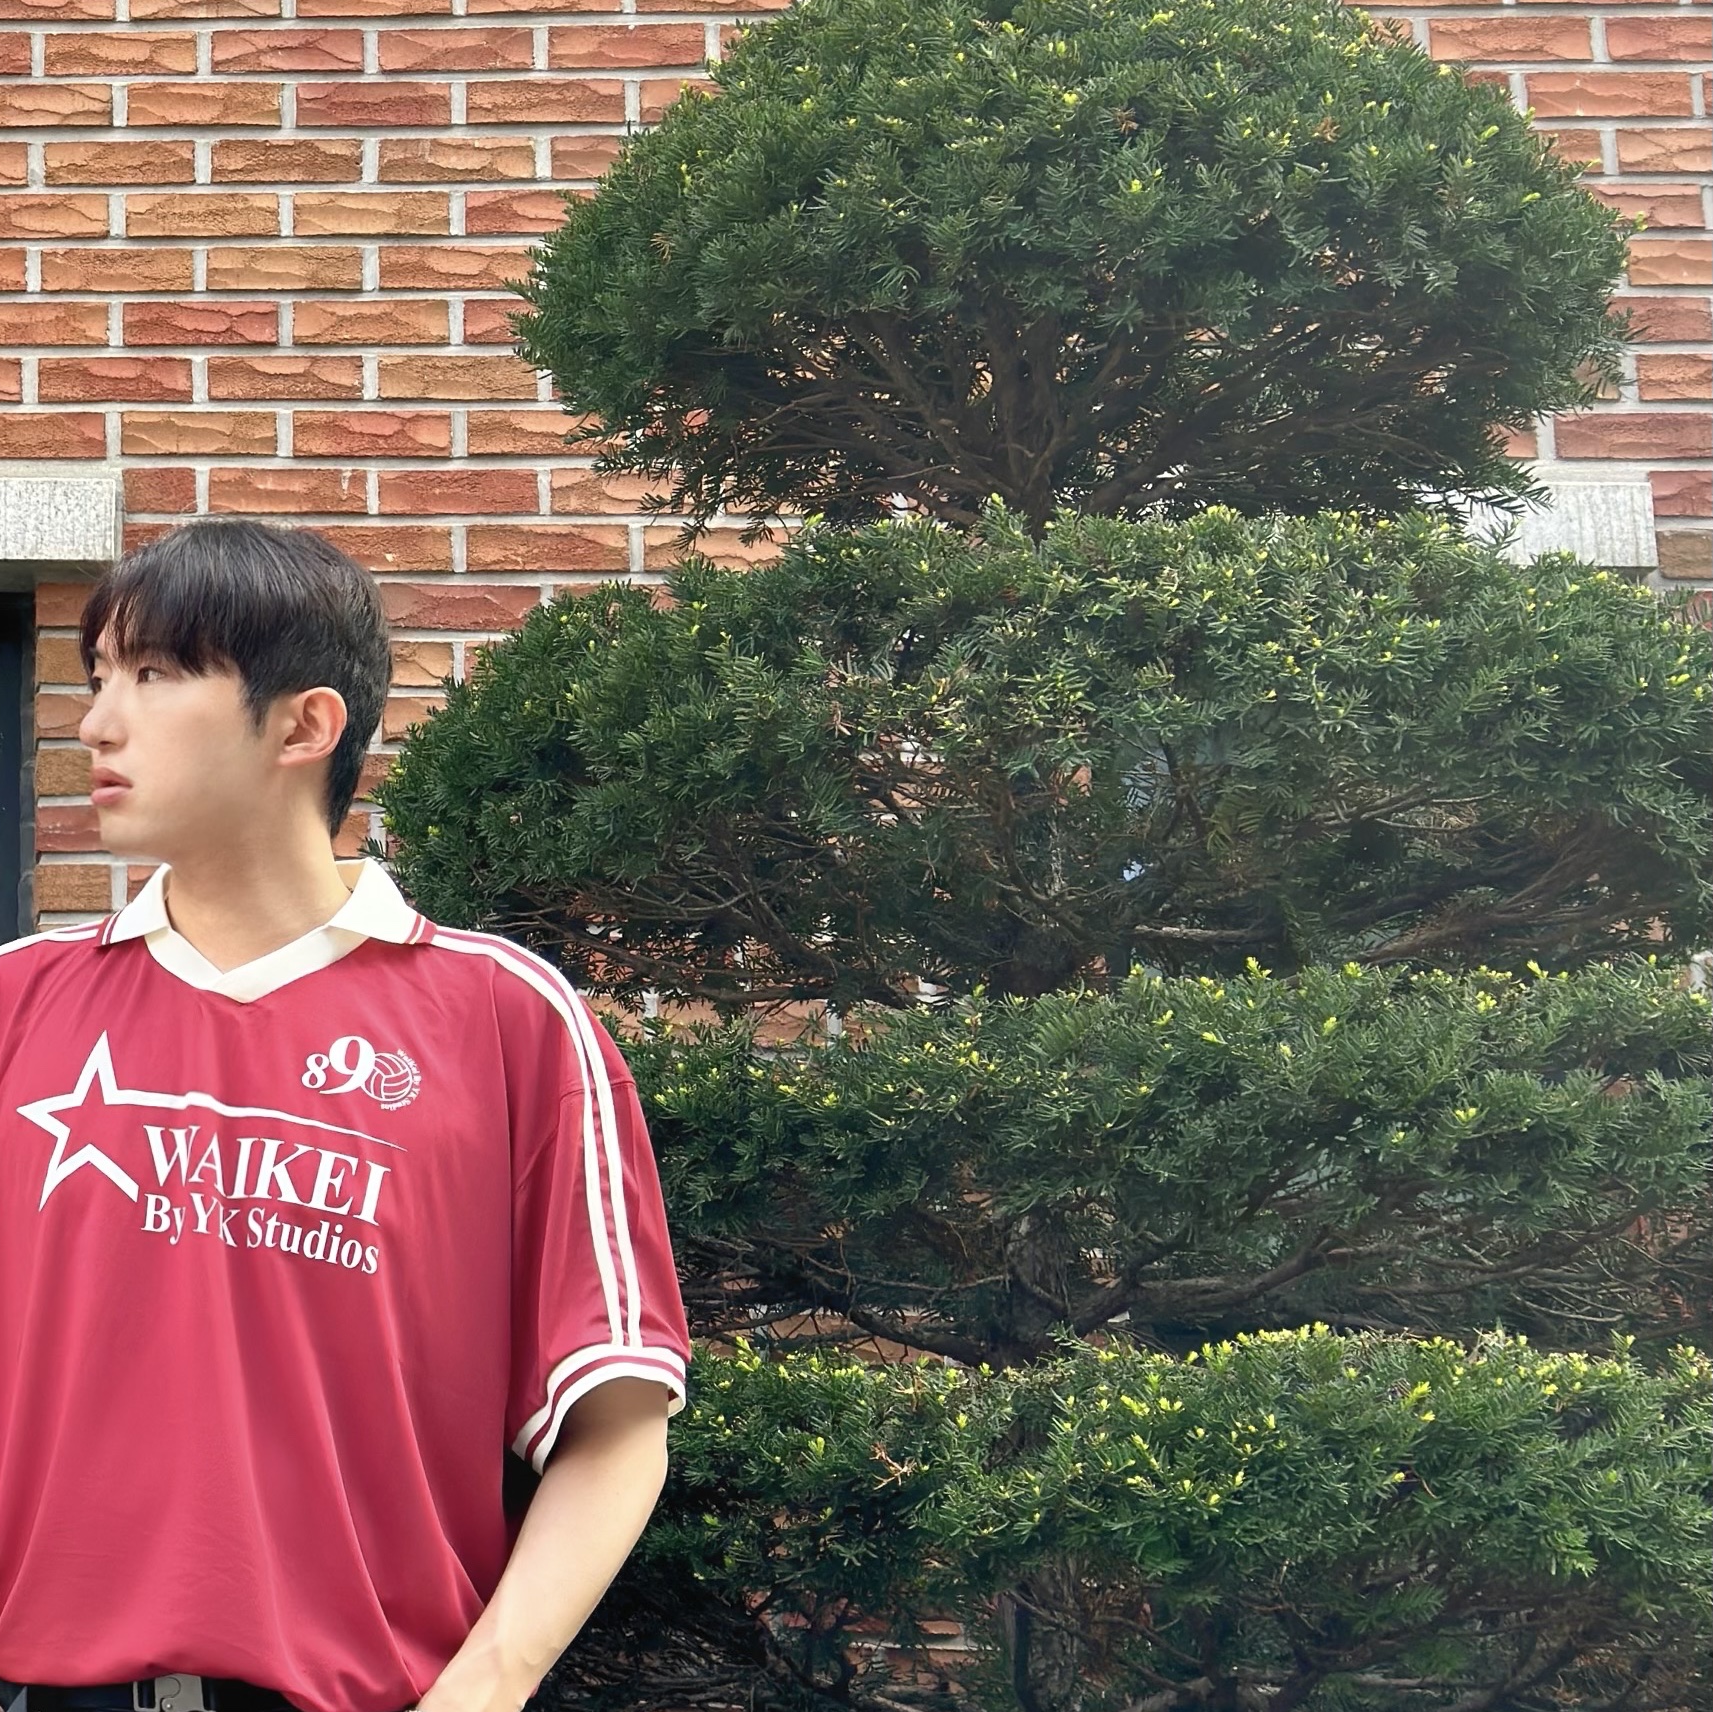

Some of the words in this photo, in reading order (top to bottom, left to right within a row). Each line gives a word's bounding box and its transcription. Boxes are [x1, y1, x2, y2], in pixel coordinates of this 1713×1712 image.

[143, 1125, 391, 1226] WAIKEI
[141, 1193, 186, 1245] By
[190, 1192, 240, 1247] YK
[247, 1207, 379, 1275] Studios
